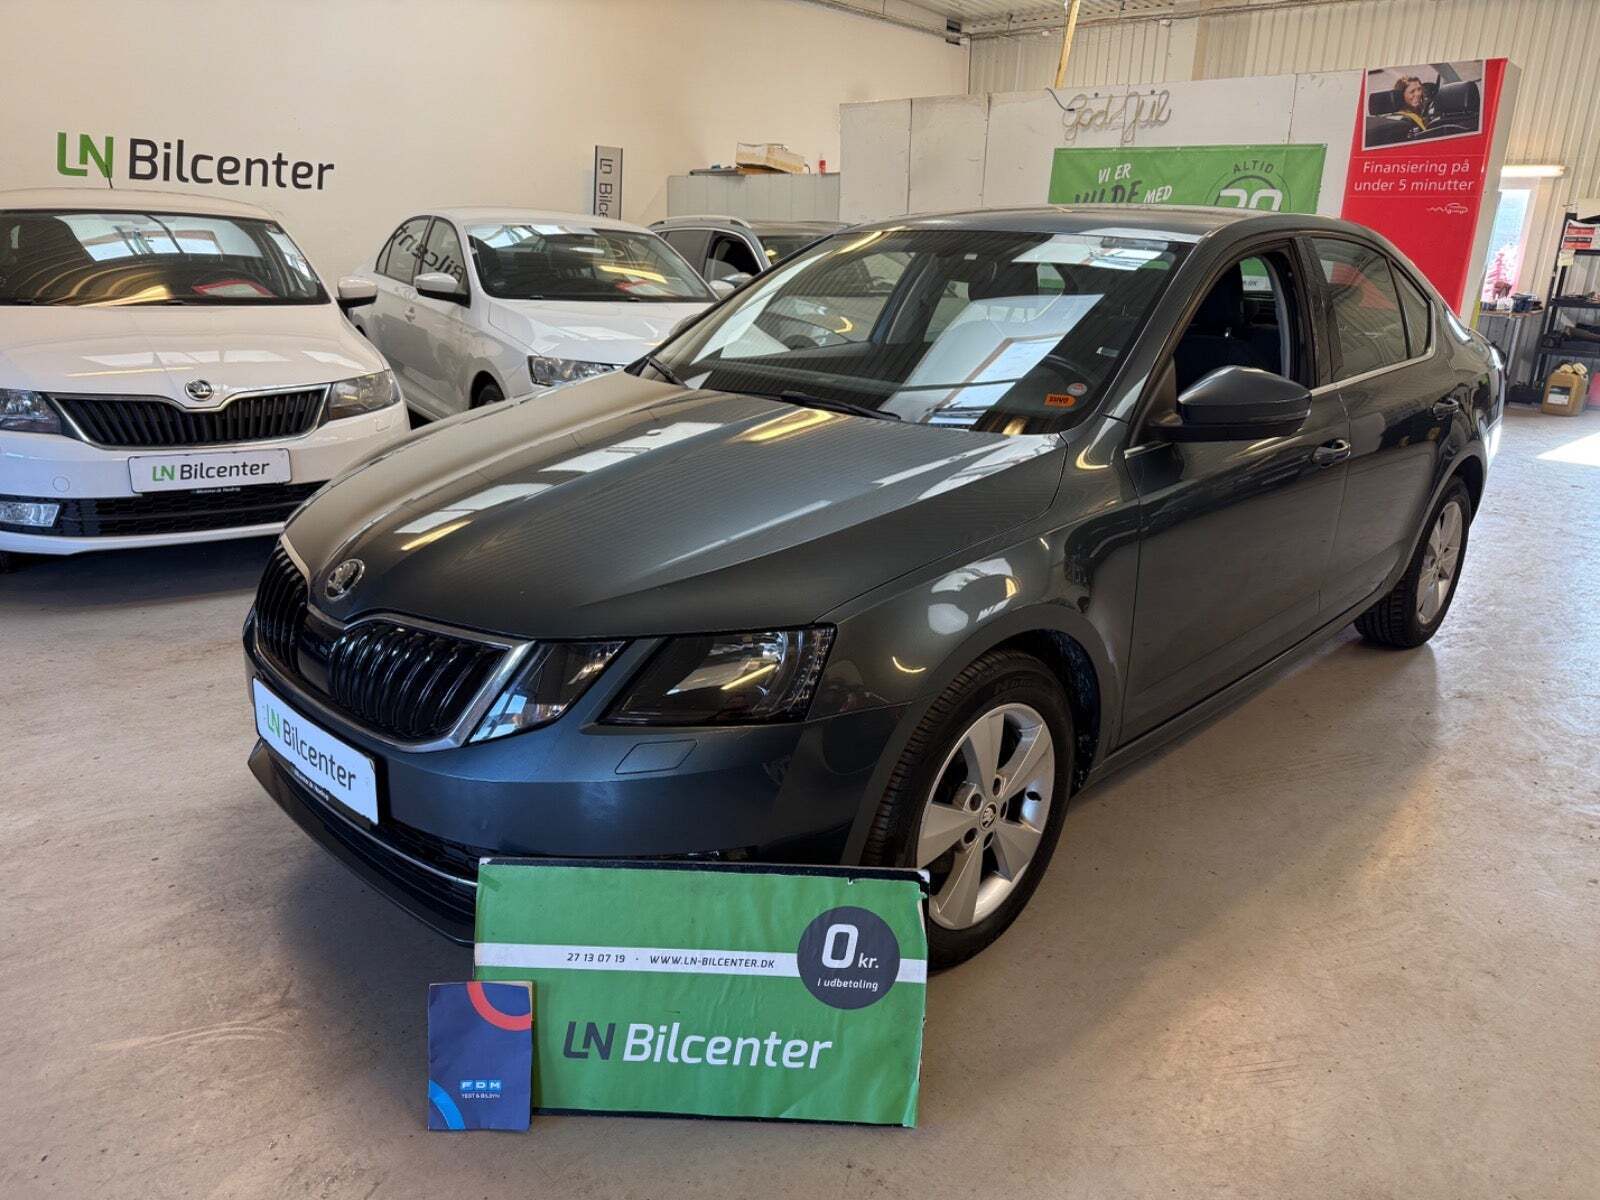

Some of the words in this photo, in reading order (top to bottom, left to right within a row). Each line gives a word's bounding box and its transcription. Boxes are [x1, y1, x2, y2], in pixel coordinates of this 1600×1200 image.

[57, 131, 114, 179] LN
[128, 137, 335, 190] Bilcenter
[1233, 159, 1275, 175] ALTID
[1362, 160, 1448, 176] Finansiering
[1450, 158, 1470, 175] på
[1098, 167, 1112, 185] VI
[1114, 162, 1132, 180] ER
[1143, 184, 1173, 204] MED
[1353, 178, 1395, 192] under
[1398, 178, 1406, 191] 5
[1410, 178, 1475, 192] minutter
[152, 464, 175, 482] LN
[179, 461, 270, 481] Bilcenter
[265, 703, 282, 739] LN
[283, 717, 357, 791] Bilcenter
[821, 923, 859, 969] 0
[858, 952, 879, 969] kr.
[566, 952, 580, 963] 27
[584, 952, 594, 963] 13
[597, 953, 611, 964] 07
[614, 953, 626, 964] 19
[650, 954, 775, 969] WWW.LN-BILCENTER.DK
[823, 978, 879, 992] udbetaling
[563, 1021, 617, 1061] LN
[622, 1021, 833, 1069] Bilcenter
